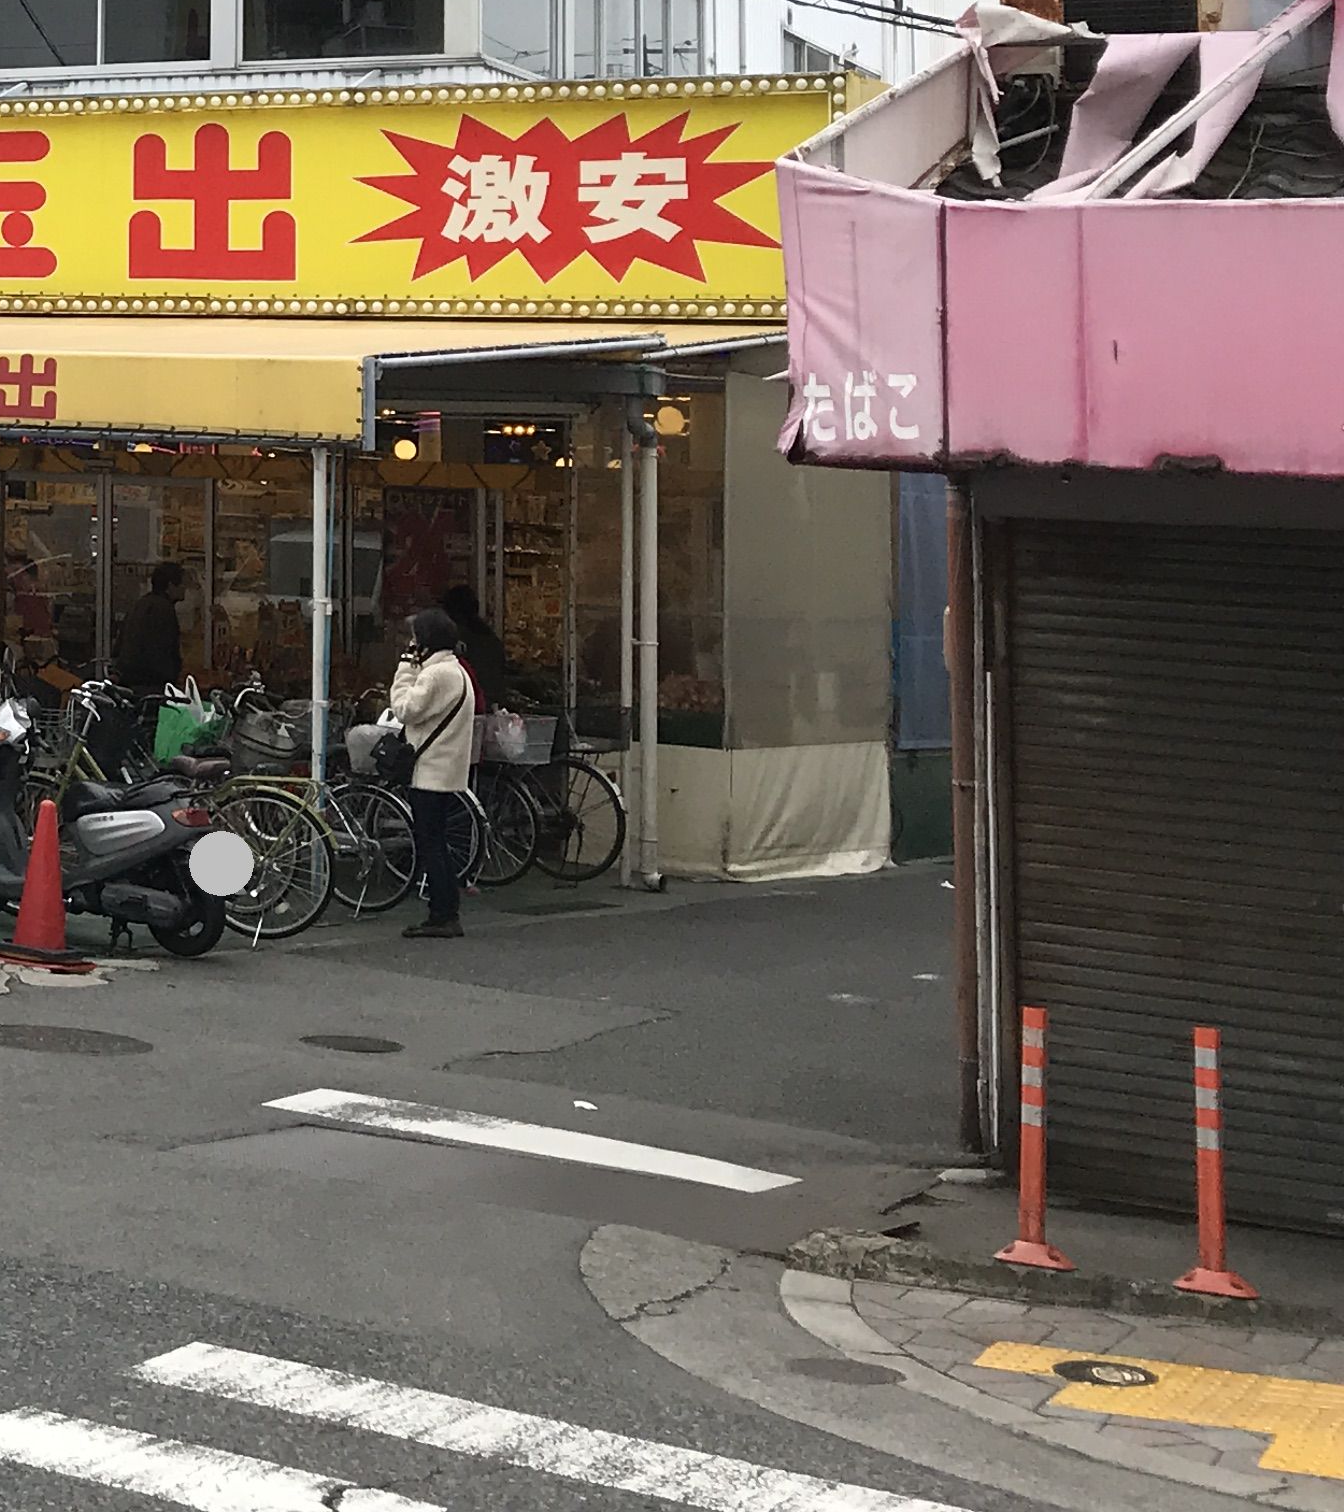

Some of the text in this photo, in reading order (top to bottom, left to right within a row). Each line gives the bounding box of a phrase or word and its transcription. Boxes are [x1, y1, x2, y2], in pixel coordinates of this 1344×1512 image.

[440, 152, 691, 244] 激安
[803, 371, 920, 442] たばこ
